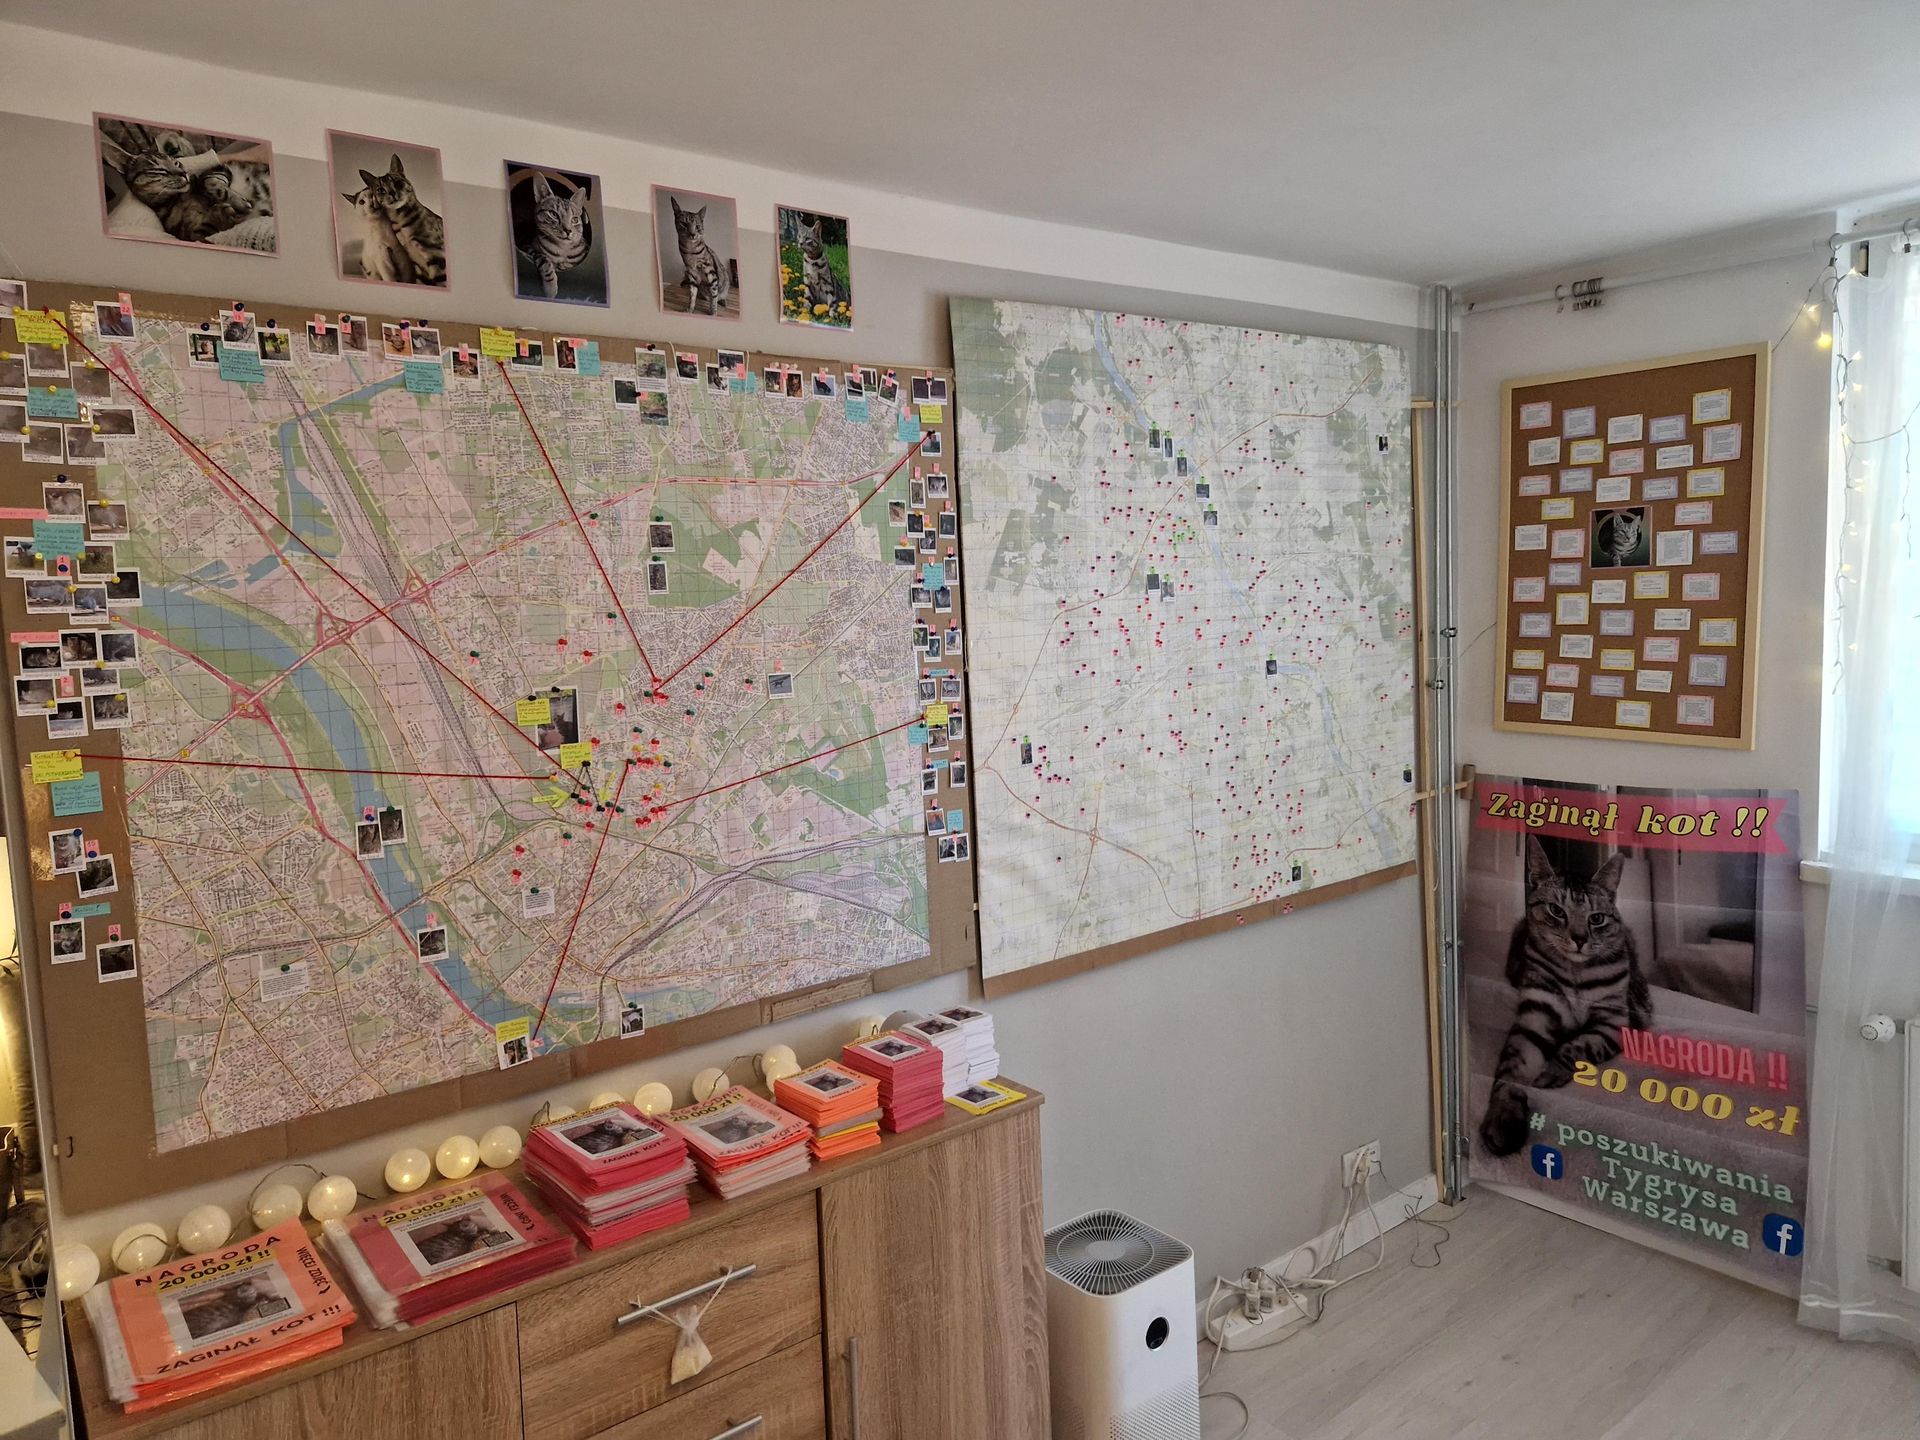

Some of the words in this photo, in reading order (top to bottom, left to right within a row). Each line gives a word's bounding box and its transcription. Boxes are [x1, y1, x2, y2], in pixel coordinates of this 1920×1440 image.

[1487, 793, 1619, 836] Zaginął
[1636, 804, 1720, 837] kot
[1731, 806, 1769, 838] !!
[1620, 1026, 1756, 1085] NAGRODA
[1573, 1060, 1628, 1094] 20
[1639, 1078, 1735, 1121] 000
[1745, 1105, 1800, 1137] zł
[1557, 1123, 1794, 1204] poszukiwania
[1602, 1155, 1739, 1217] Tygrysa
[384, 1212, 407, 1225] 20
[410, 1201, 445, 1216] 000
[1582, 1175, 1751, 1250] Warszawa
[135, 1235, 281, 1287] NAGRODA
[159, 1276, 186, 1291] 20
[191, 1263, 230, 1279] 000
[236, 1255, 254, 1267] zł
[270, 1312, 317, 1336] KOT
